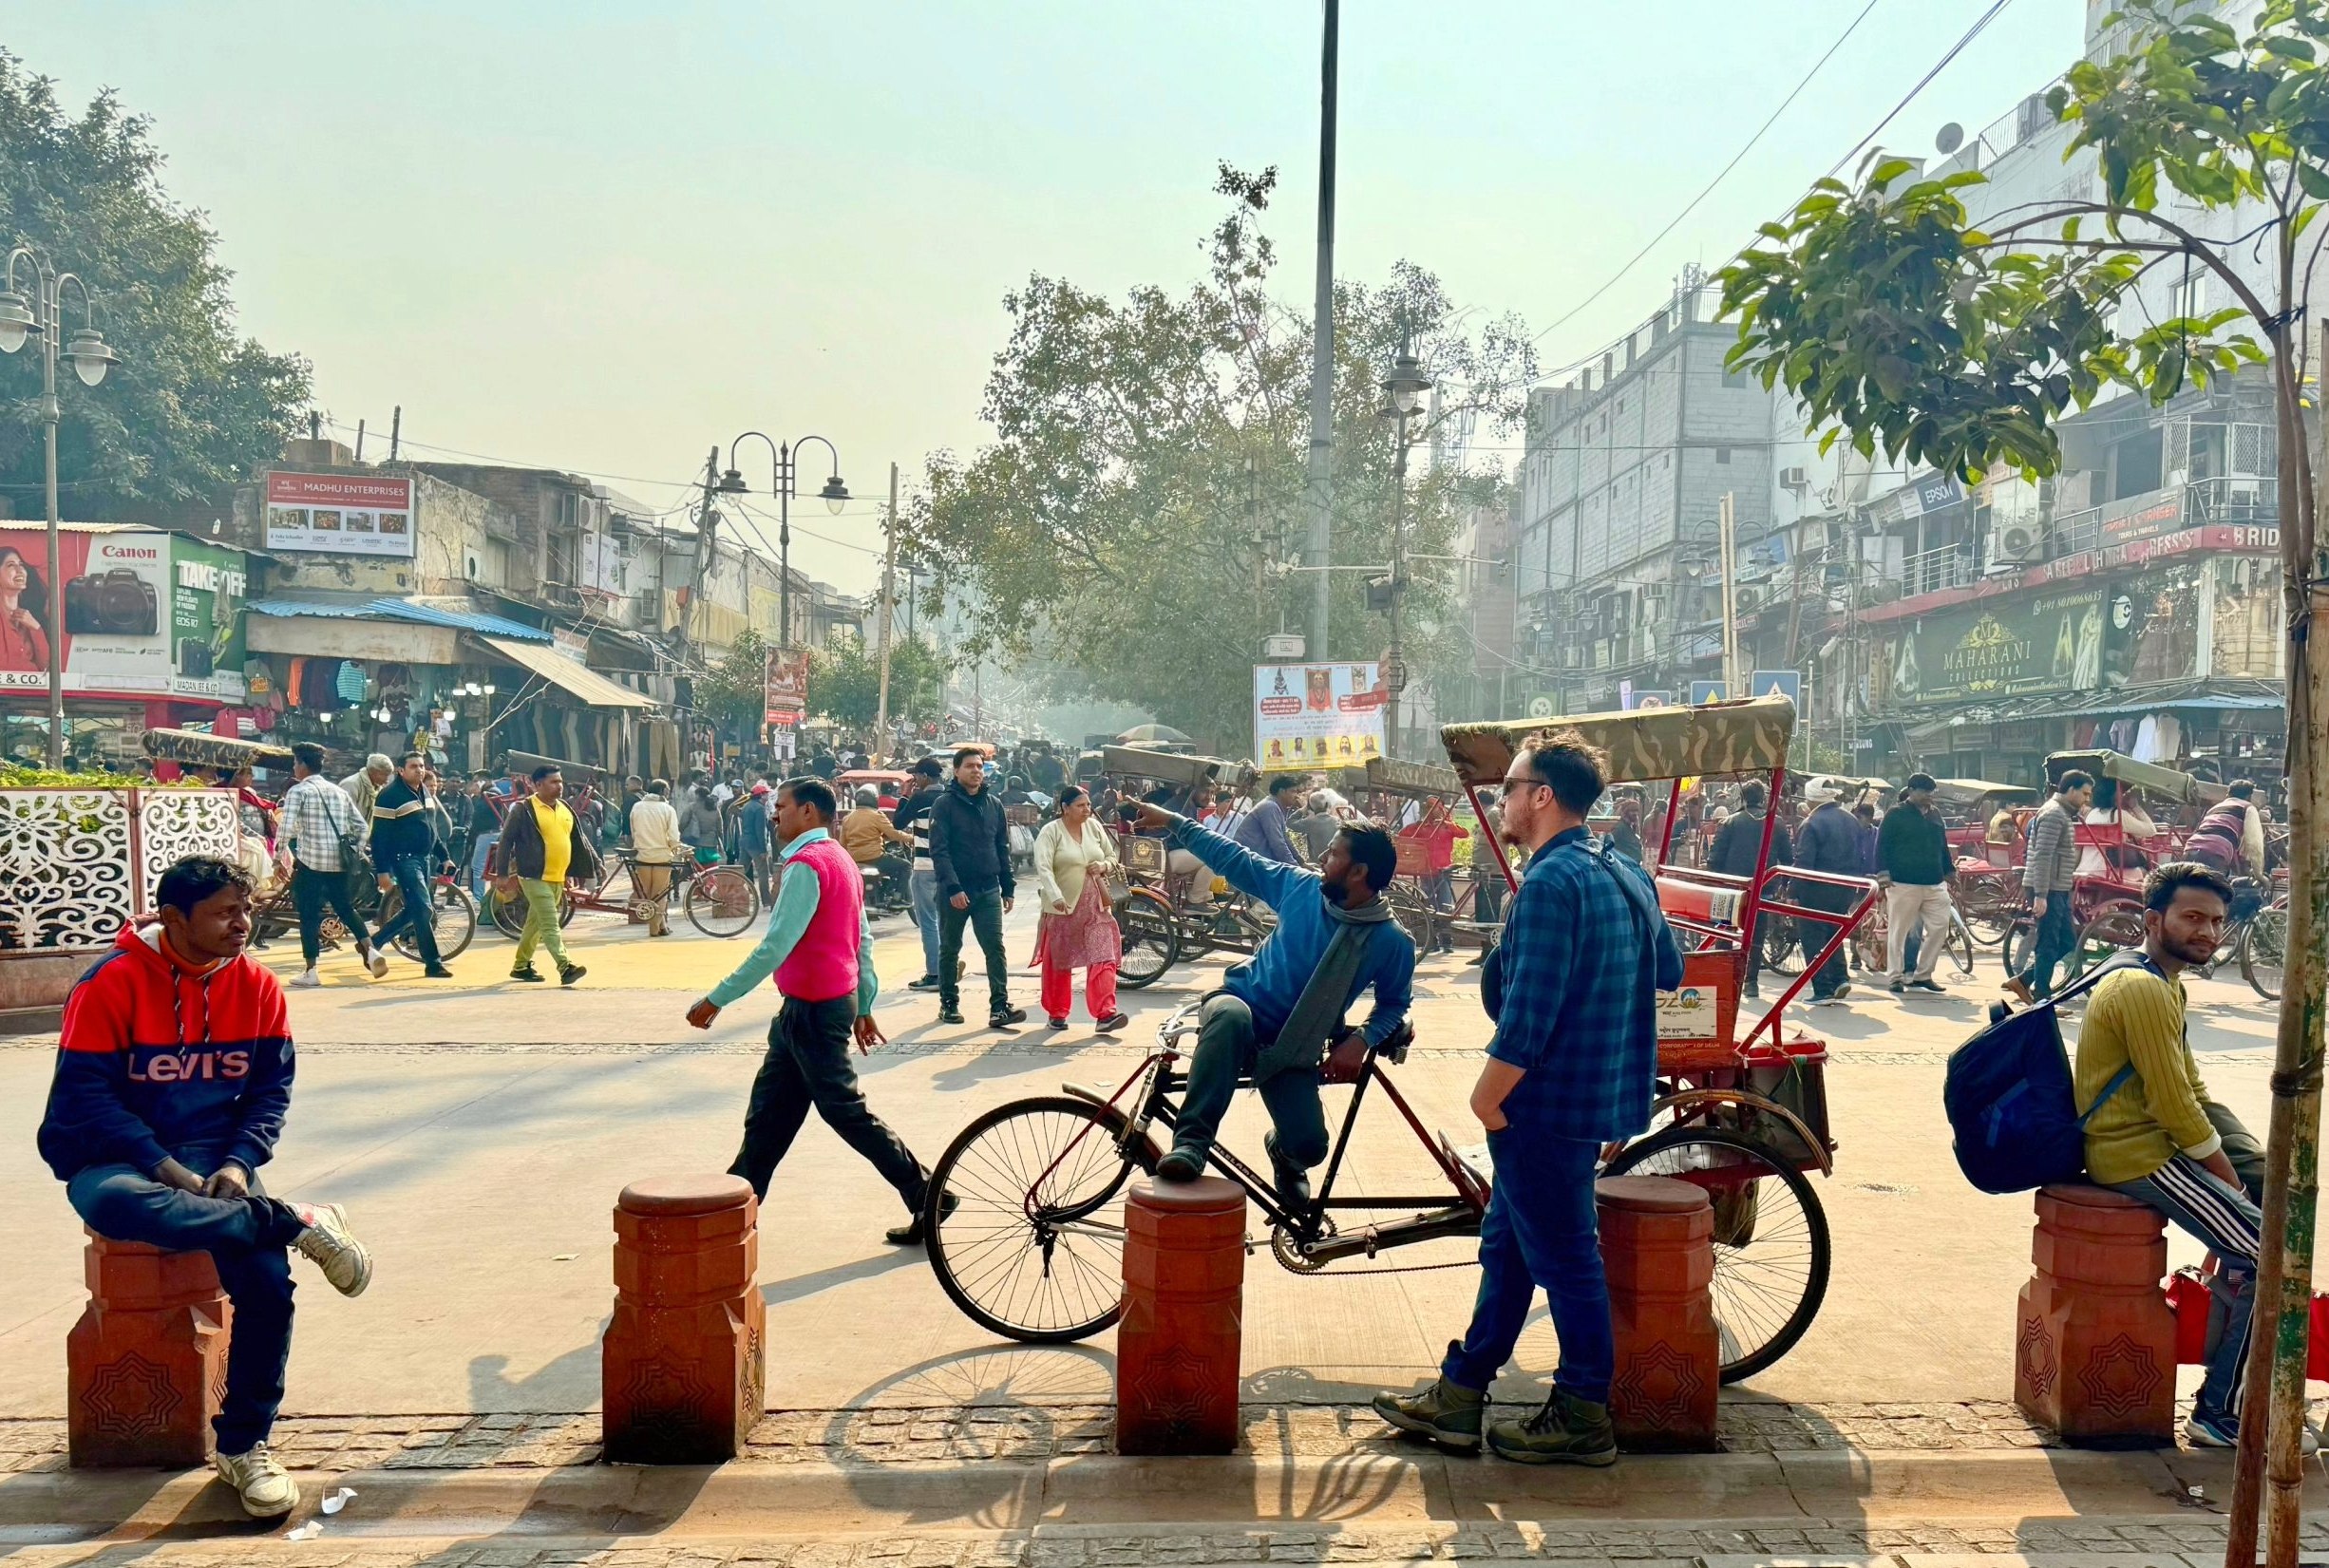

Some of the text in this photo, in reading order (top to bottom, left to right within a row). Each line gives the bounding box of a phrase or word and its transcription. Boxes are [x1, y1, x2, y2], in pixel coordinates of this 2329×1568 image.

[304, 482, 342, 493] MADHU
[344, 486, 405, 496] ENTERPRISES
[1924, 484, 1954, 504] EPSON
[2118, 530, 2132, 540] TOURS
[2138, 524, 2159, 535] TRAVELS
[102, 545, 157, 558] Canon
[177, 560, 247, 597] TAKE OFF
[176, 616, 199, 628] EOS R7
[1943, 641, 2032, 671] MAHARANI
[7, 674, 42, 684] & CO.
[1949, 665, 2020, 683] COLLECTIONS
[177, 680, 197, 691] MADAN
[128, 1050, 250, 1082] Levi's
